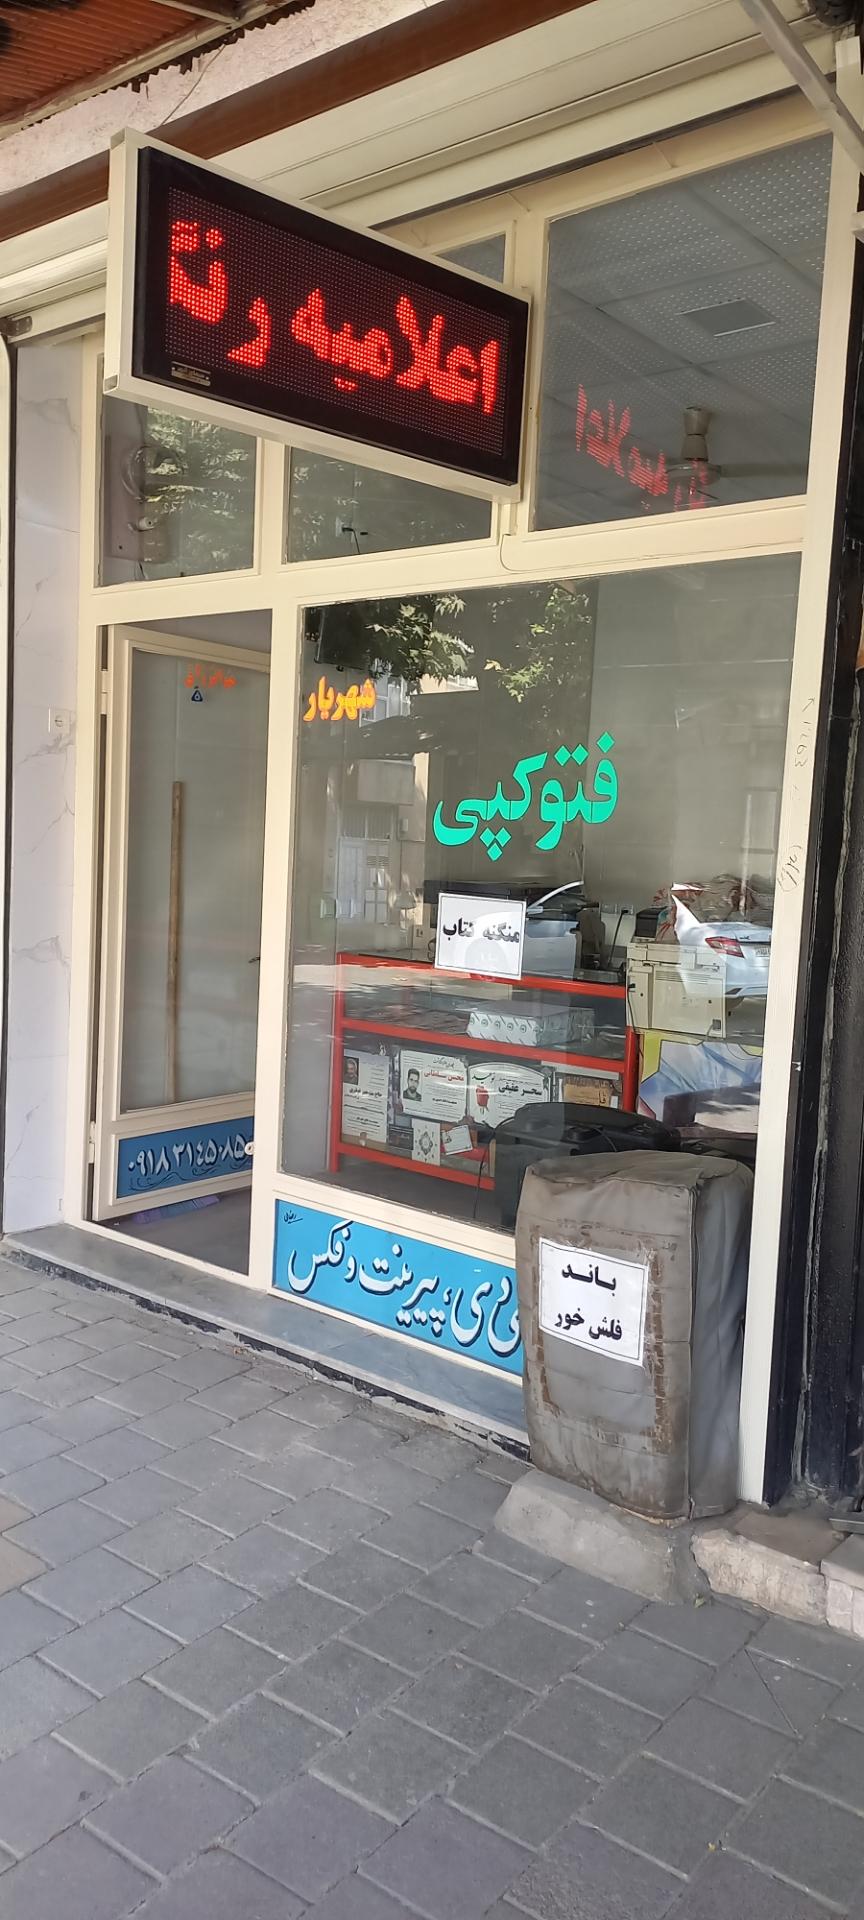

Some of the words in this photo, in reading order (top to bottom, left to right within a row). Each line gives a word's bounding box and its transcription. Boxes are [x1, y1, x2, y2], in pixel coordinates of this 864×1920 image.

[289, 287, 500, 416] اعلامیه
[302, 675, 377, 722] شهریار
[432, 731, 619, 862] فتوکپی
[286, 1219, 355, 1294] فکس
[343, 1255, 358, 1283] و
[561, 1263, 617, 1297] باند
[554, 1307, 585, 1331] خور
[588, 1316, 623, 1341] فلش
